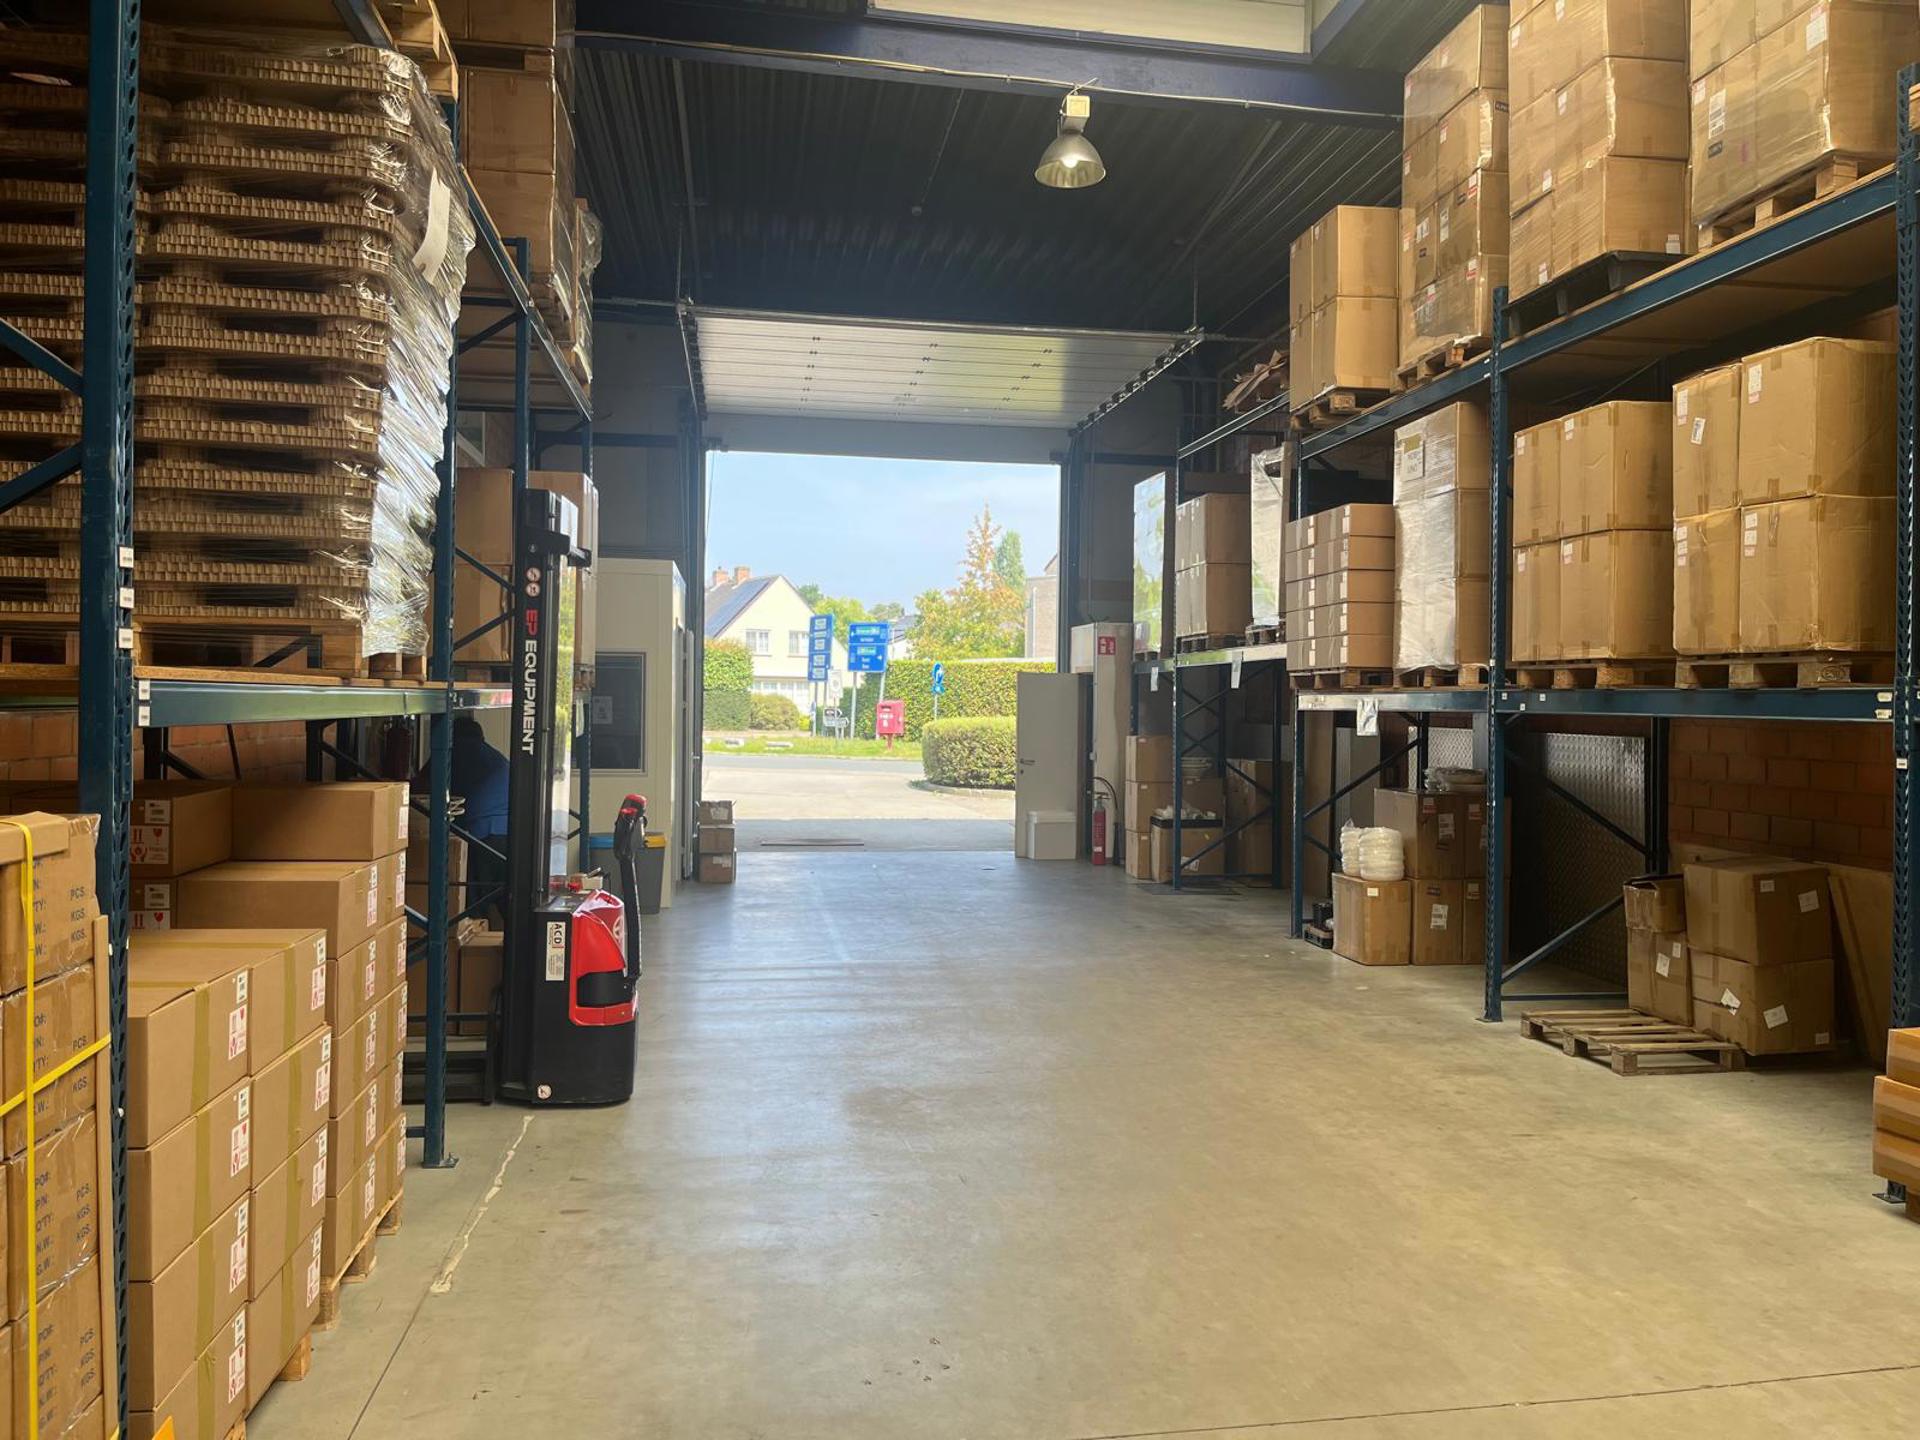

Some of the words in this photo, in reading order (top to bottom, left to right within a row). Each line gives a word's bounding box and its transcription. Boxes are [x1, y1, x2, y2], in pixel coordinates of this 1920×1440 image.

[526, 609, 539, 636] EP
[521, 639, 538, 756] EQUIPMENT
[554, 923, 563, 944] ACD
